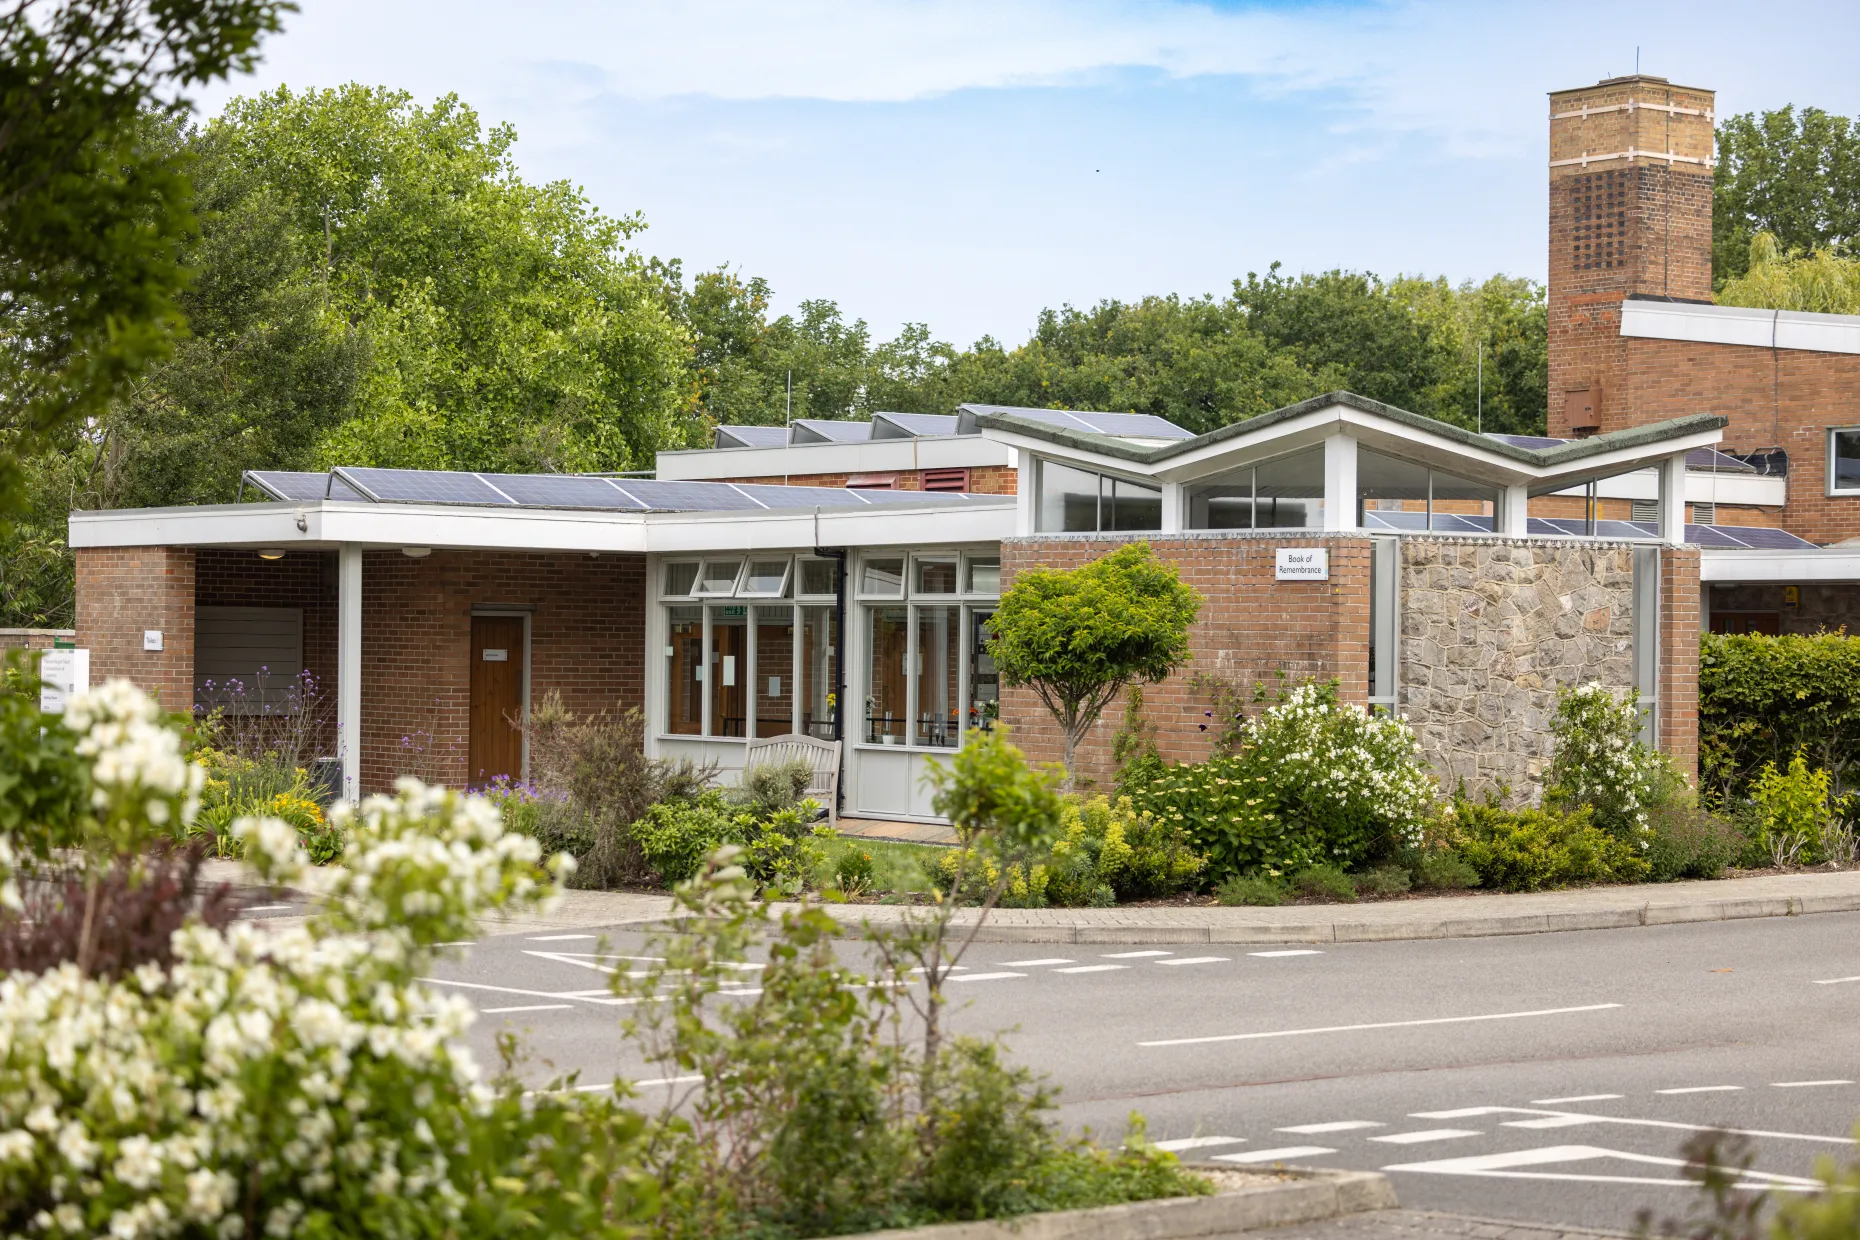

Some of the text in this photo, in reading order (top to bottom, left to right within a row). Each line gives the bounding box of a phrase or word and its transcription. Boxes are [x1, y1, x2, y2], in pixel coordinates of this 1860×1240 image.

[1288, 554, 1313, 563] Book of
[1279, 565, 1322, 574] Remembrance
